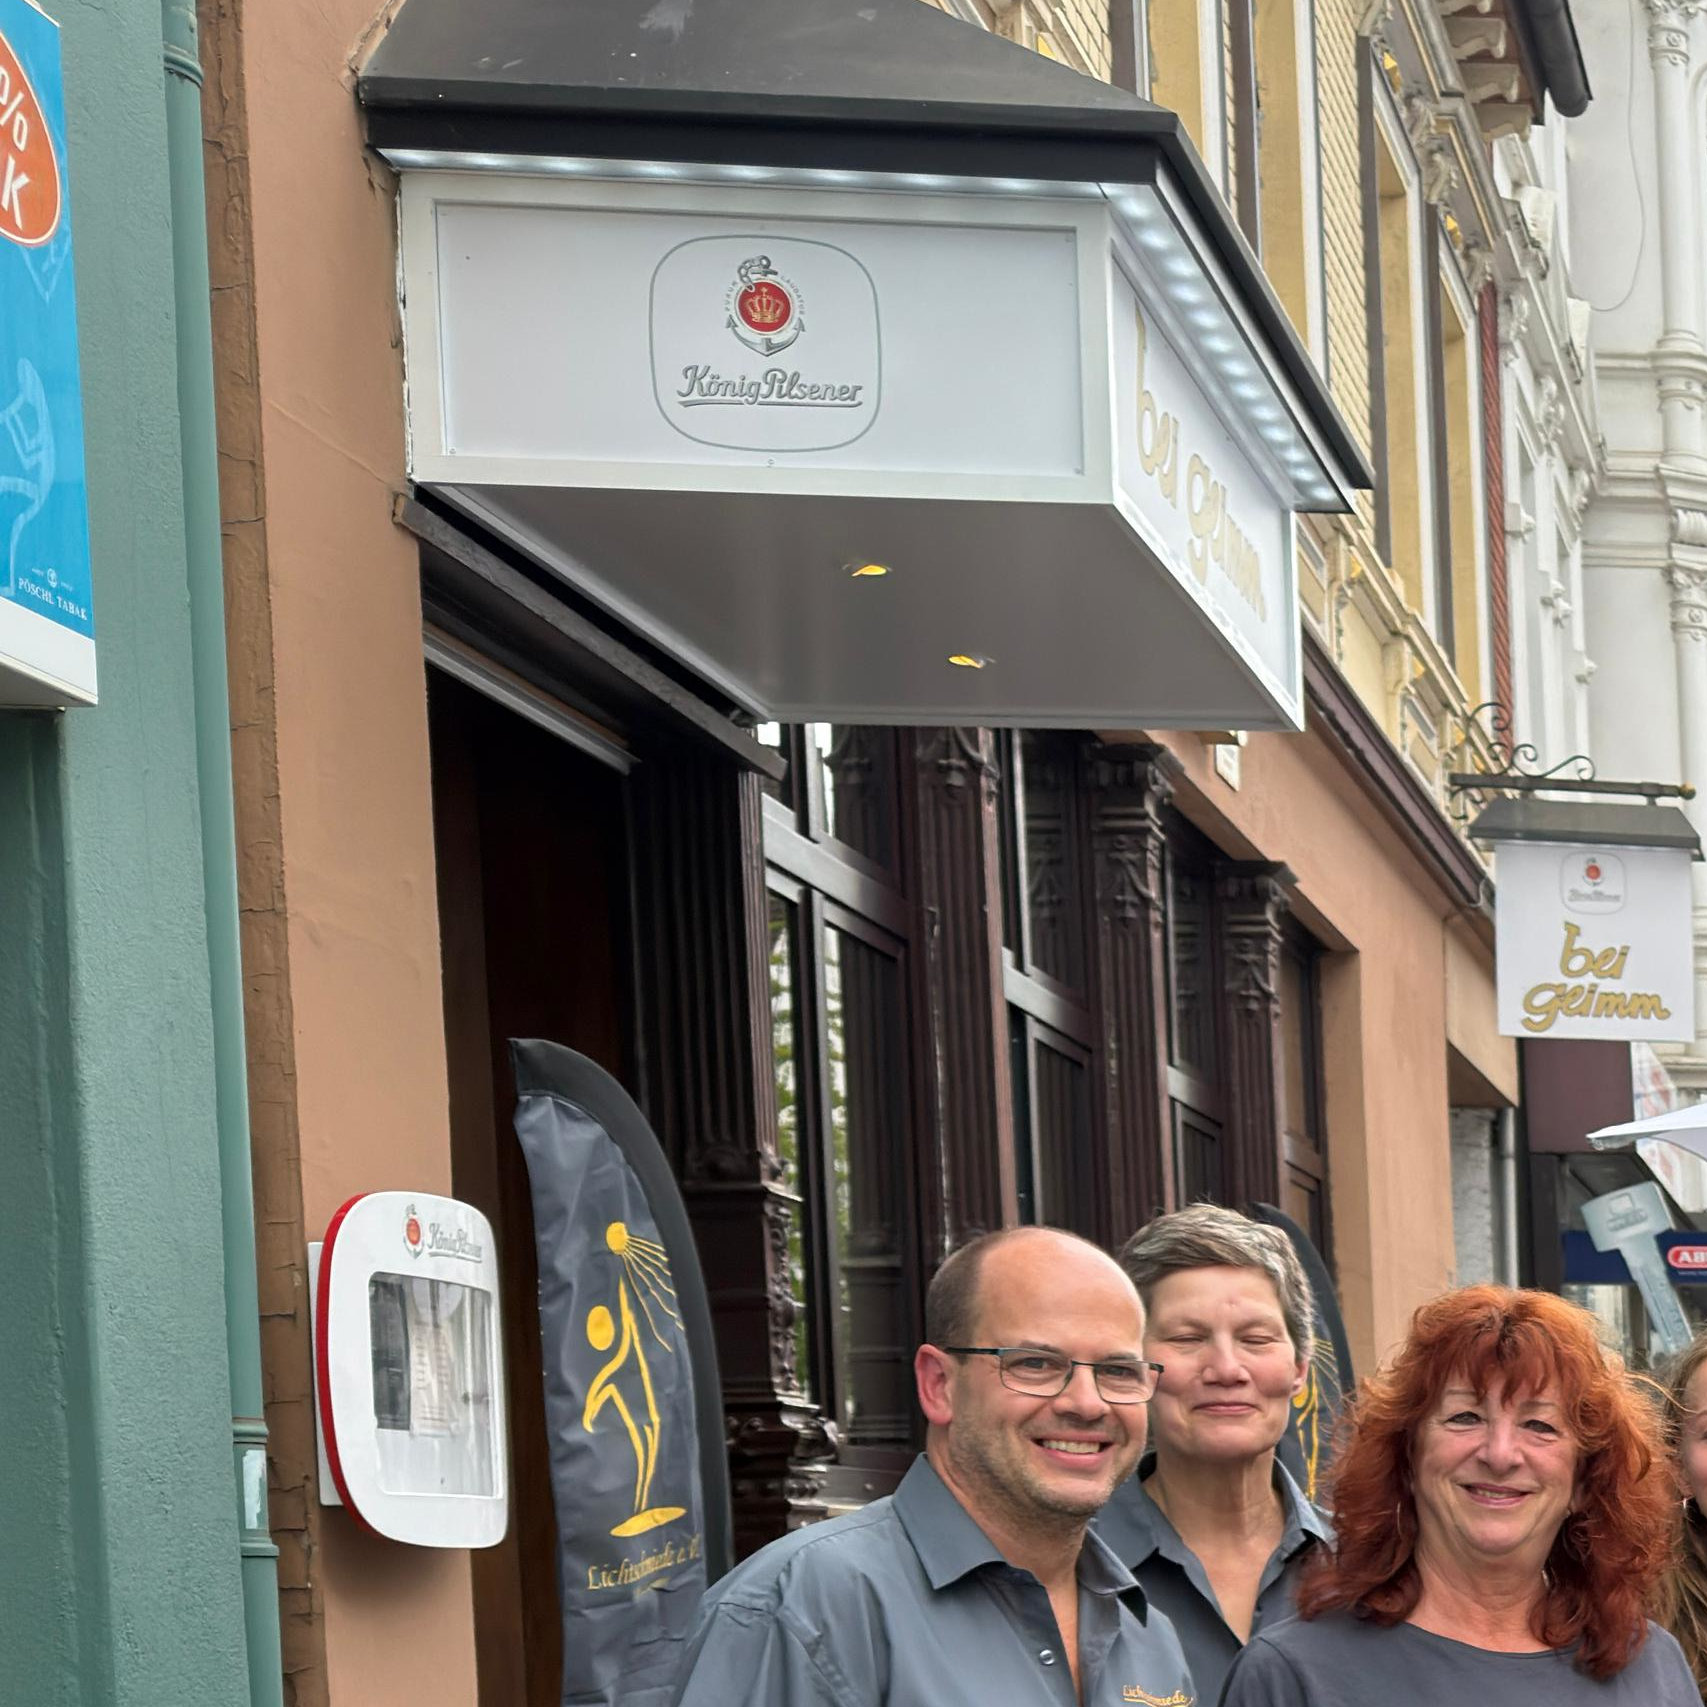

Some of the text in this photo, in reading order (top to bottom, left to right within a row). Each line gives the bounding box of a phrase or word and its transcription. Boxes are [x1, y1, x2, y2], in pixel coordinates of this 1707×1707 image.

[676, 364, 863, 405] König Pilsener
[18, 577, 88, 620] PÖSCHL TABAK
[1560, 920, 1631, 980] bei
